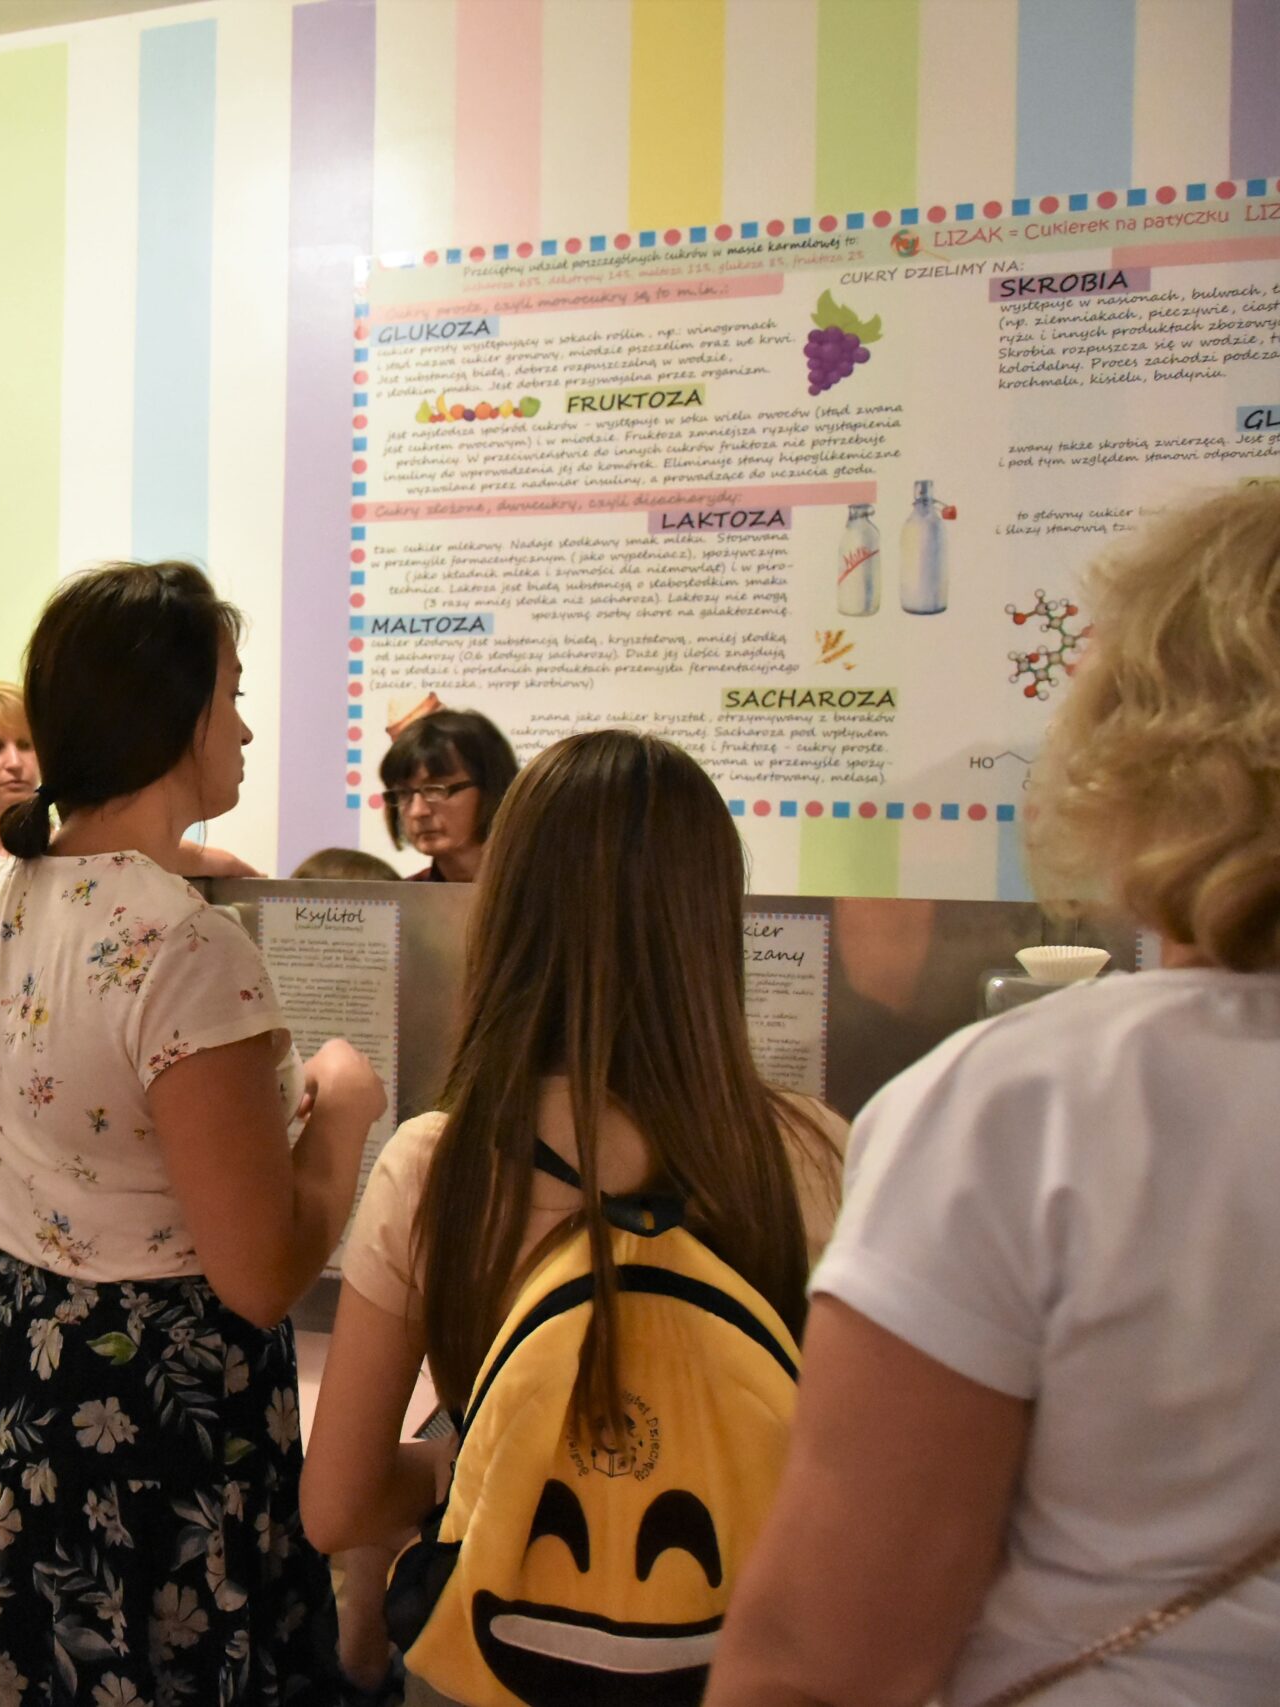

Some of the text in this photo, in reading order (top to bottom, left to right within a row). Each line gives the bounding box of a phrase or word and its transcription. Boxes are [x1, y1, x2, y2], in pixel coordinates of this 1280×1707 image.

[933, 226, 1003, 247] LIZAK
[1024, 218, 1109, 240] Cukierek
[1115, 217, 1136, 231] na
[1143, 208, 1229, 230] patyczku
[840, 260, 1024, 285] CUKRY DZIELIMY NA:
[1001, 270, 1129, 298] SKROBIA
[1000, 297, 1072, 315] występuje
[1096, 289, 1184, 305] nasionach,
[1190, 283, 1266, 299] bulwach,
[1034, 308, 1142, 326] ziemniakach,
[1148, 304, 1234, 322] pieczywie,
[1242, 301, 1280, 312] ciast
[378, 319, 490, 343] GLUKOZA
[998, 331, 1032, 346] ryżu
[1052, 326, 1106, 342] innych
[1110, 320, 1202, 340] produktach
[998, 344, 1056, 358] Skrobia
[1060, 342, 1146, 356] rozpuszcza
[1154, 338, 1174, 351] się
[1200, 333, 1264, 346] wodzie,
[998, 349, 1280, 373] koloidalny. Proces zachodzi podcza
[998, 374, 1084, 388] krochmalu,
[1090, 371, 1146, 384] kisielu,
[567, 389, 703, 413] FRUKTOZA
[1244, 409, 1280, 430] GL
[1008, 445, 1052, 456] zwany
[1058, 440, 1094, 452] także
[1098, 437, 1148, 450] skrobią
[1234, 432, 1262, 444] Jest
[1008, 454, 1032, 470] pod
[1038, 455, 1064, 469] tym
[1070, 451, 1138, 467] względem
[1144, 449, 1198, 461] stanowi
[662, 510, 785, 529] LAKTOZA
[1016, 510, 1028, 520] to
[1032, 508, 1082, 523] główny
[1088, 505, 1134, 518] cukier
[1046, 521, 1106, 534] stanowią
[371, 616, 485, 634] MALTOZA
[725, 688, 896, 708] SACHAROZA
[295, 906, 366, 926] Ksylitol
[743, 948, 806, 968] czany
